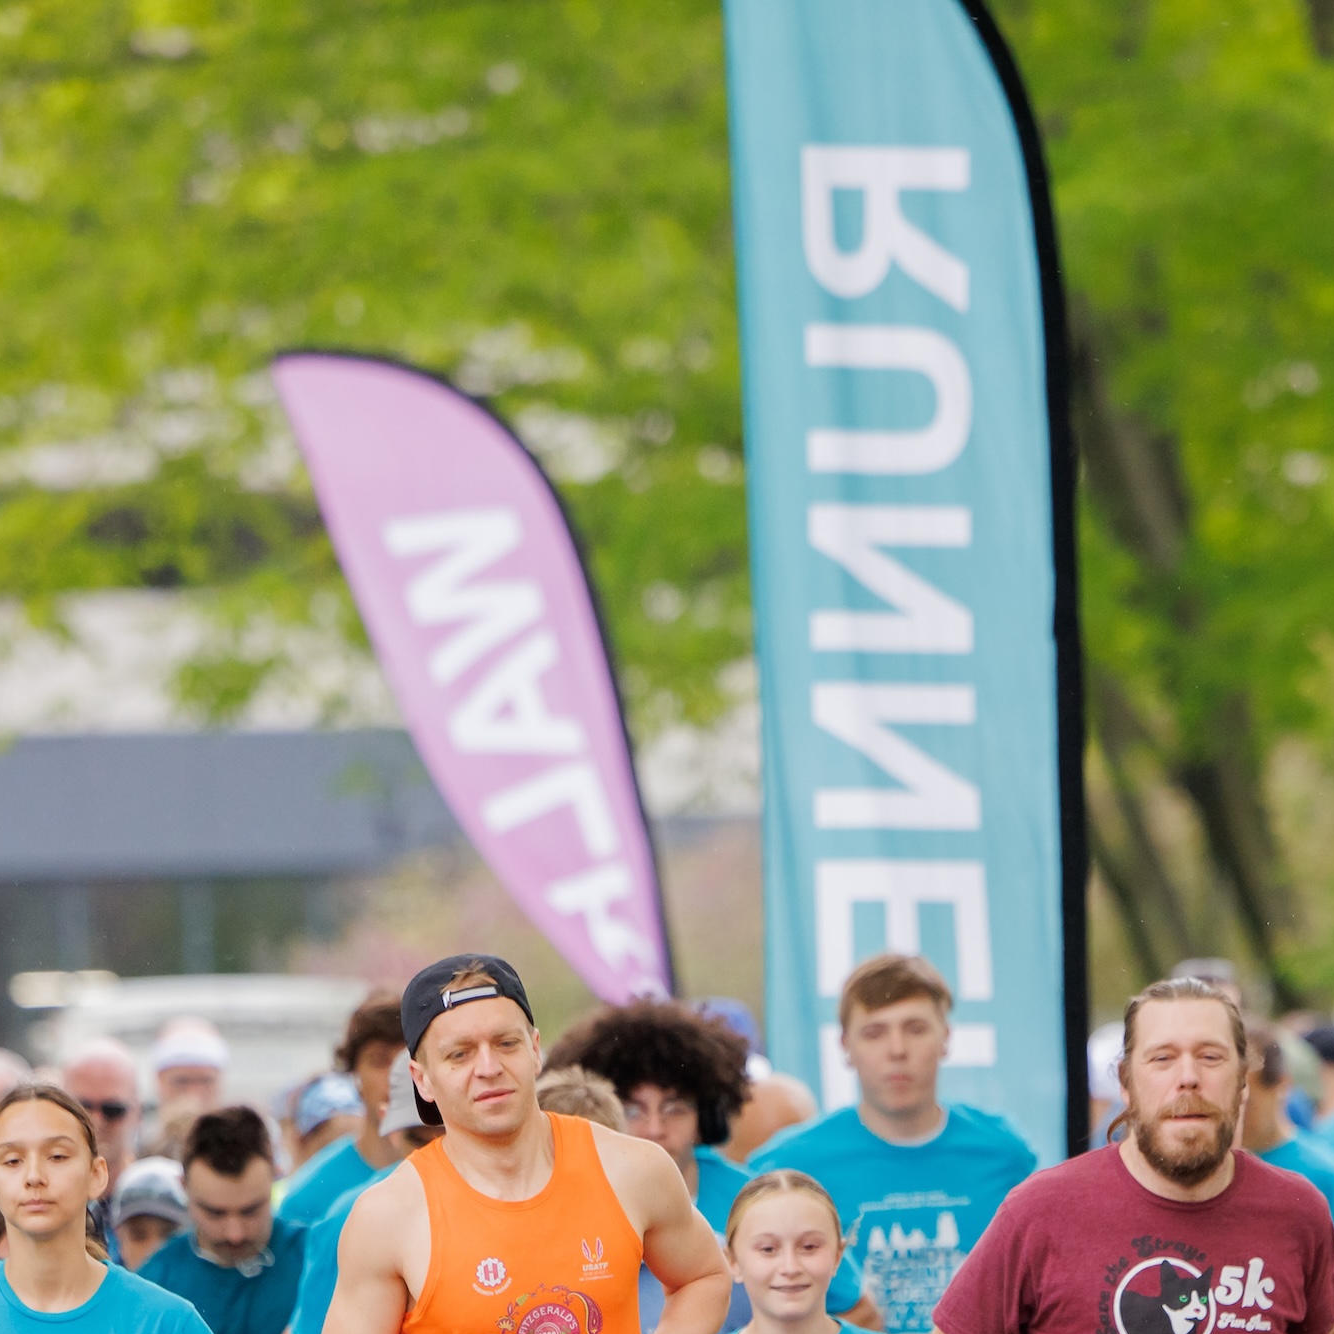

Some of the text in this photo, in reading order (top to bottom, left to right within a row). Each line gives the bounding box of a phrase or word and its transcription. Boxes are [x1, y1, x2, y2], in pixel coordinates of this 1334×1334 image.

[582, 1262, 609, 1272] USATF
[1105, 1257, 1129, 1285] the
[1131, 1235, 1206, 1262] Strays
[1215, 1256, 1275, 1310] 5k
[518, 1305, 578, 1334] FITZGERALD'S
